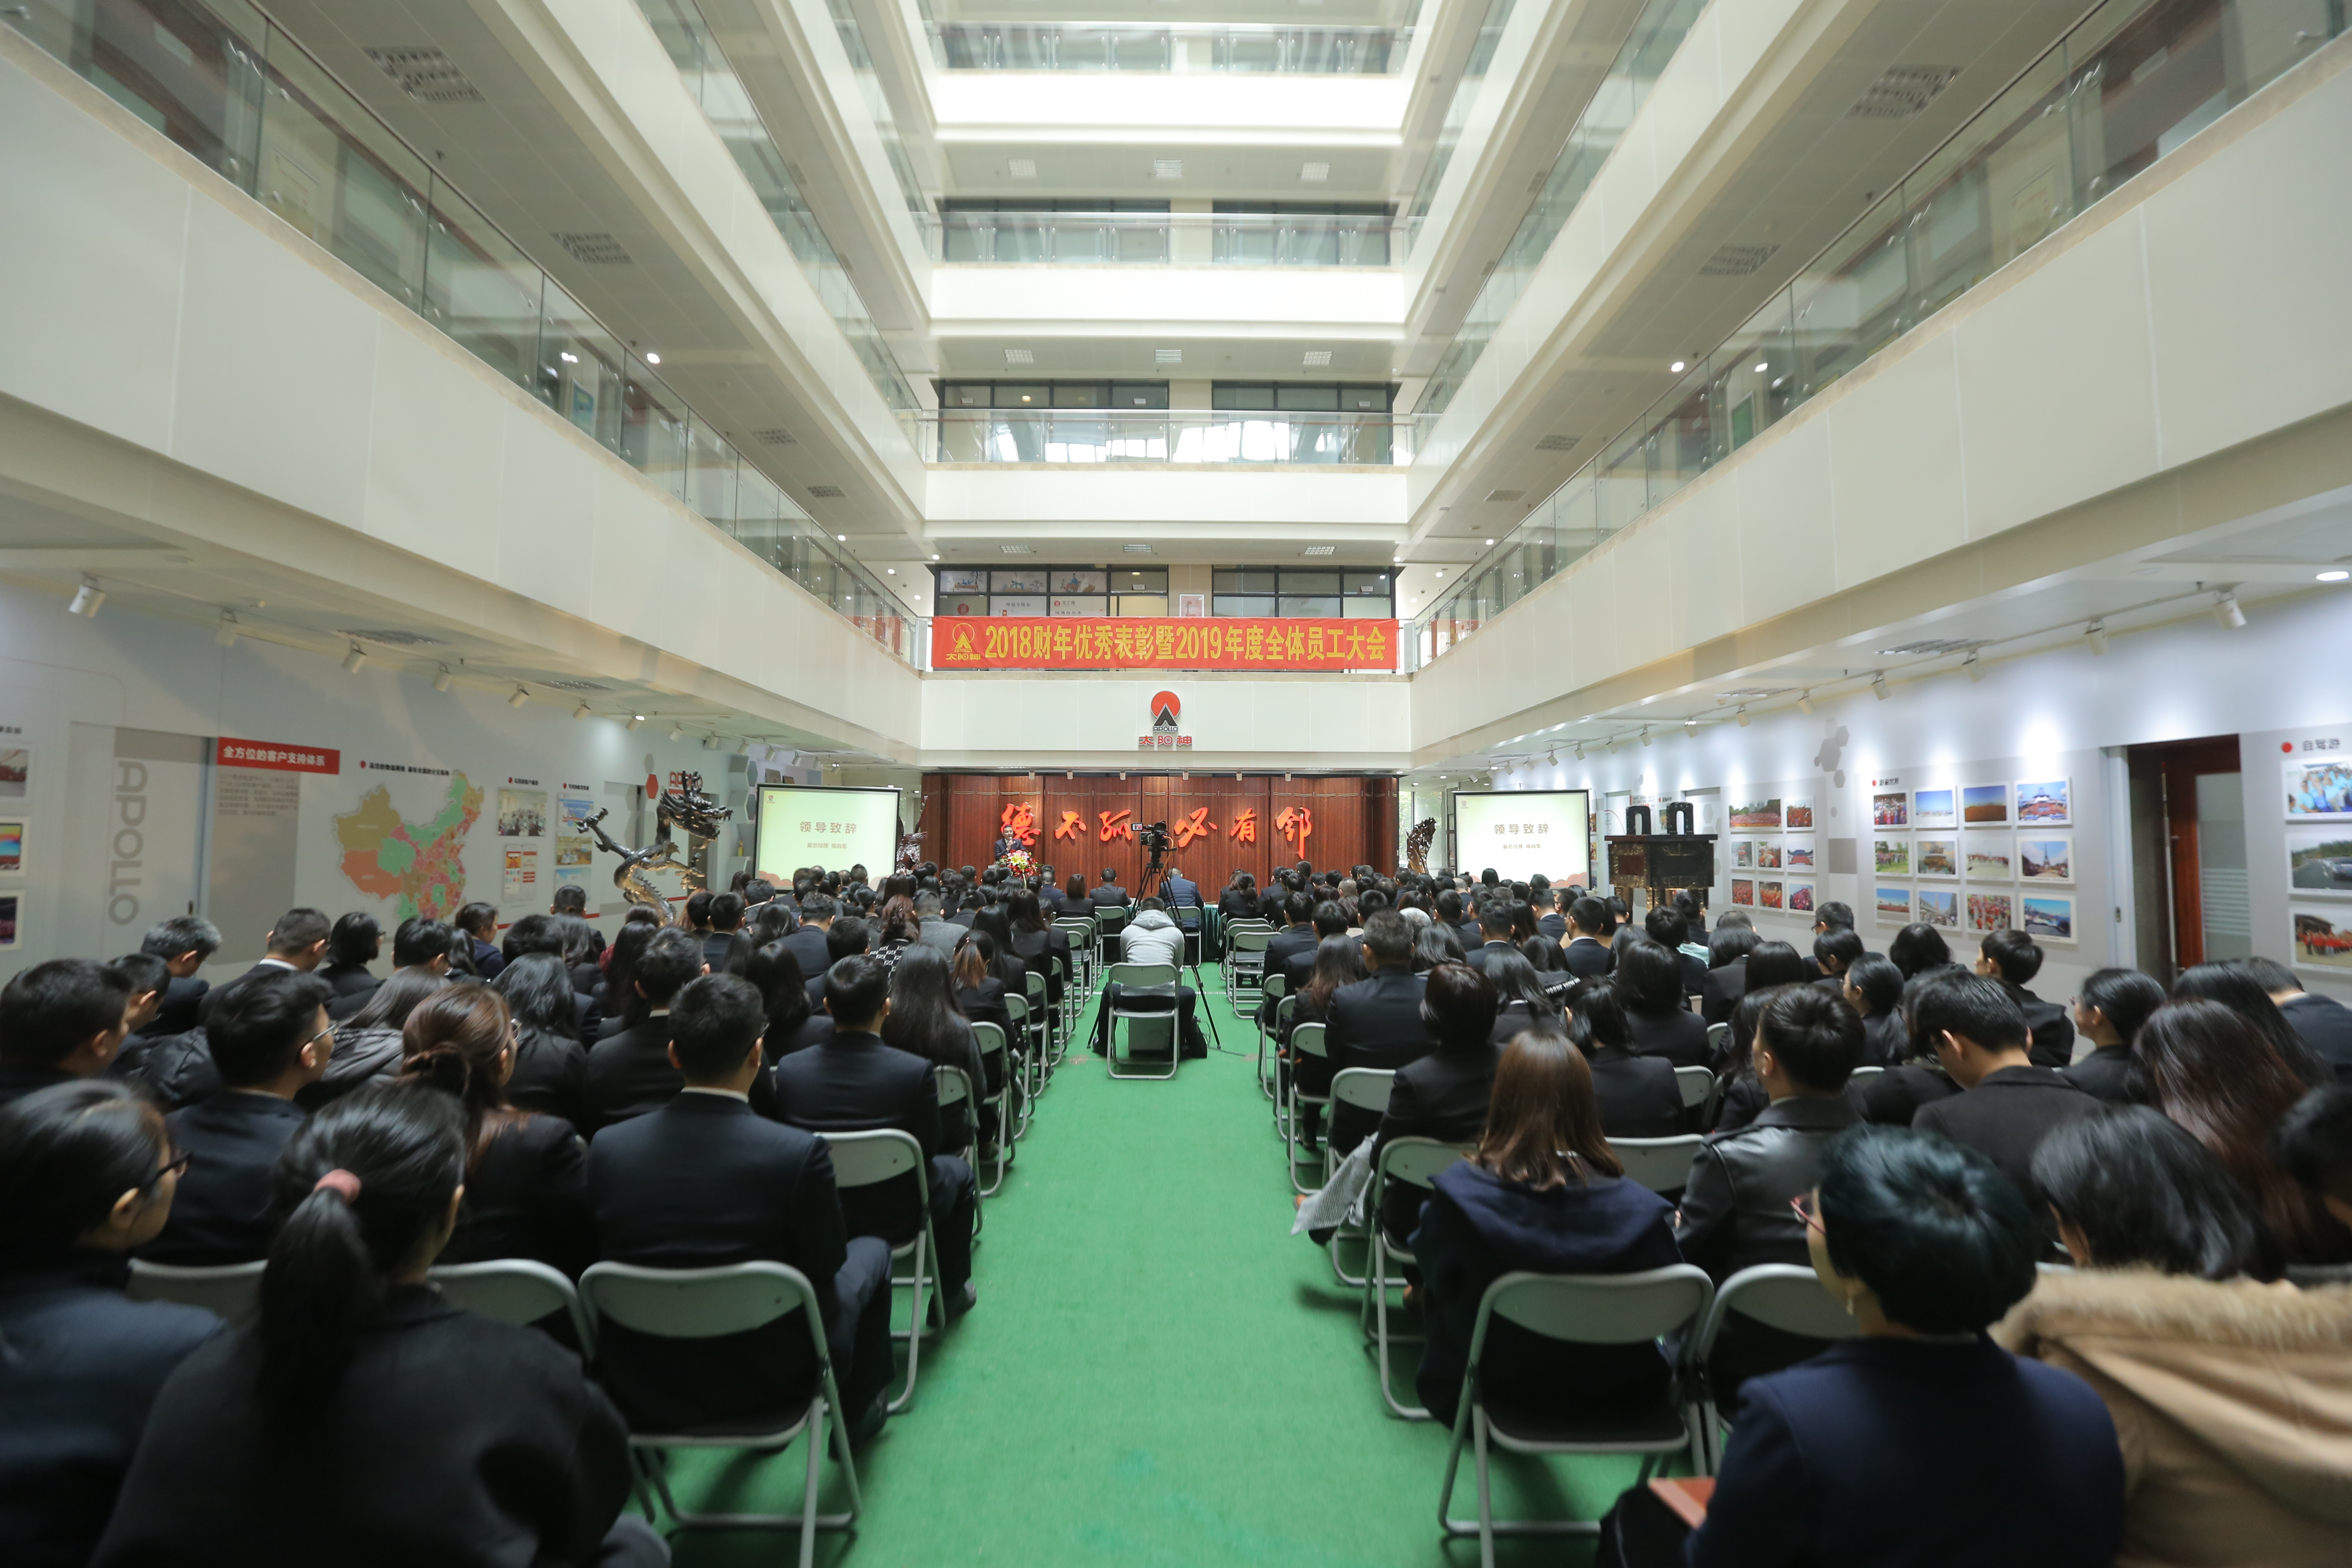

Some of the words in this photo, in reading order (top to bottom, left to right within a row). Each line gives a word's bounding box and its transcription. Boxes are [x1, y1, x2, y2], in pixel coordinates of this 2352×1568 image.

[985, 625, 1386, 661] 2018财年优秀表彰暨2019年度全体员工大会
[1139, 735, 1192, 745] 太阳神
[223, 745, 325, 766] 全方位的客户支持体系
[800, 821, 857, 834] 领导致辞
[1494, 823, 1549, 835] 领导致辞
[109, 761, 148, 926] APOLLO
